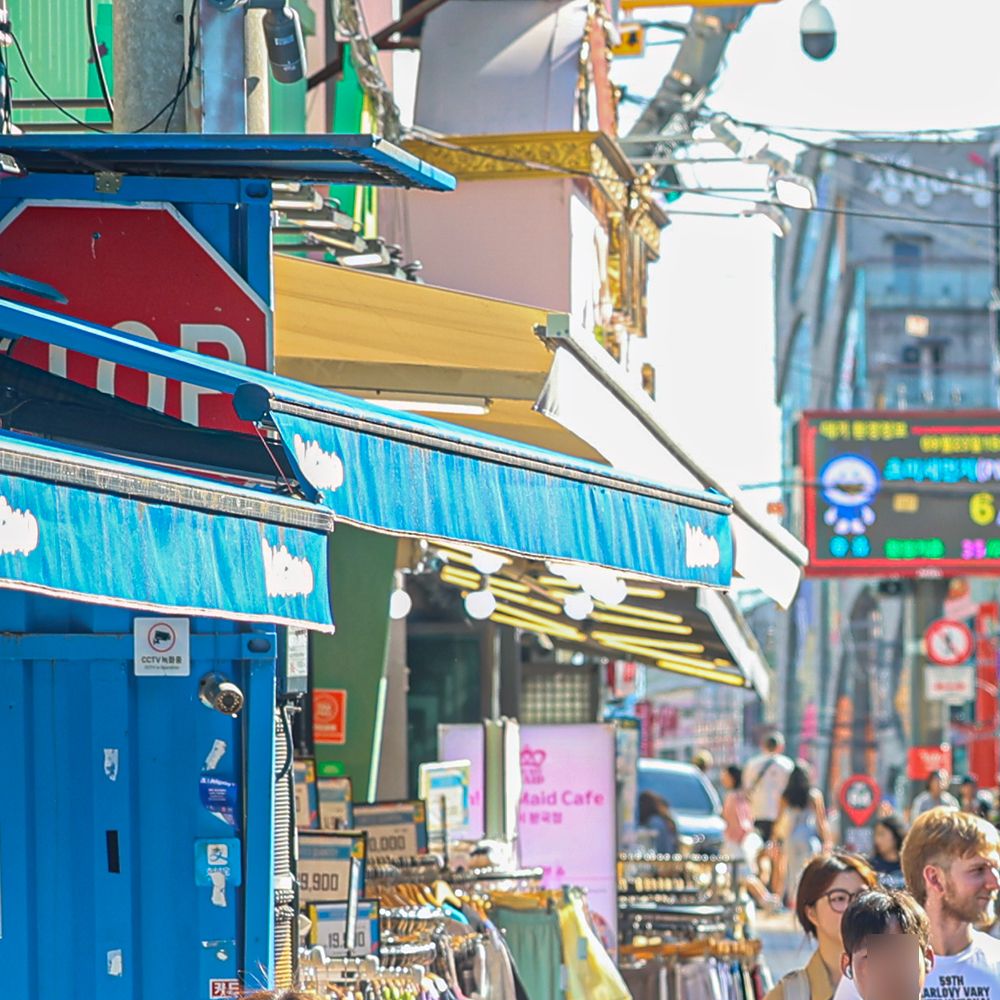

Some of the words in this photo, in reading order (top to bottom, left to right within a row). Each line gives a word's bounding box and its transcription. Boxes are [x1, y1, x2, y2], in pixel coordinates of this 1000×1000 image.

[969, 491, 995, 525] 6
[141, 656, 160, 664] CCTV
[561, 790, 605, 806] Cafe
[298, 872, 339, 892] 9,900
[939, 975, 964, 987] 59TH
[922, 986, 962, 999] ARLOVY
[964, 986, 990, 999] VARY
